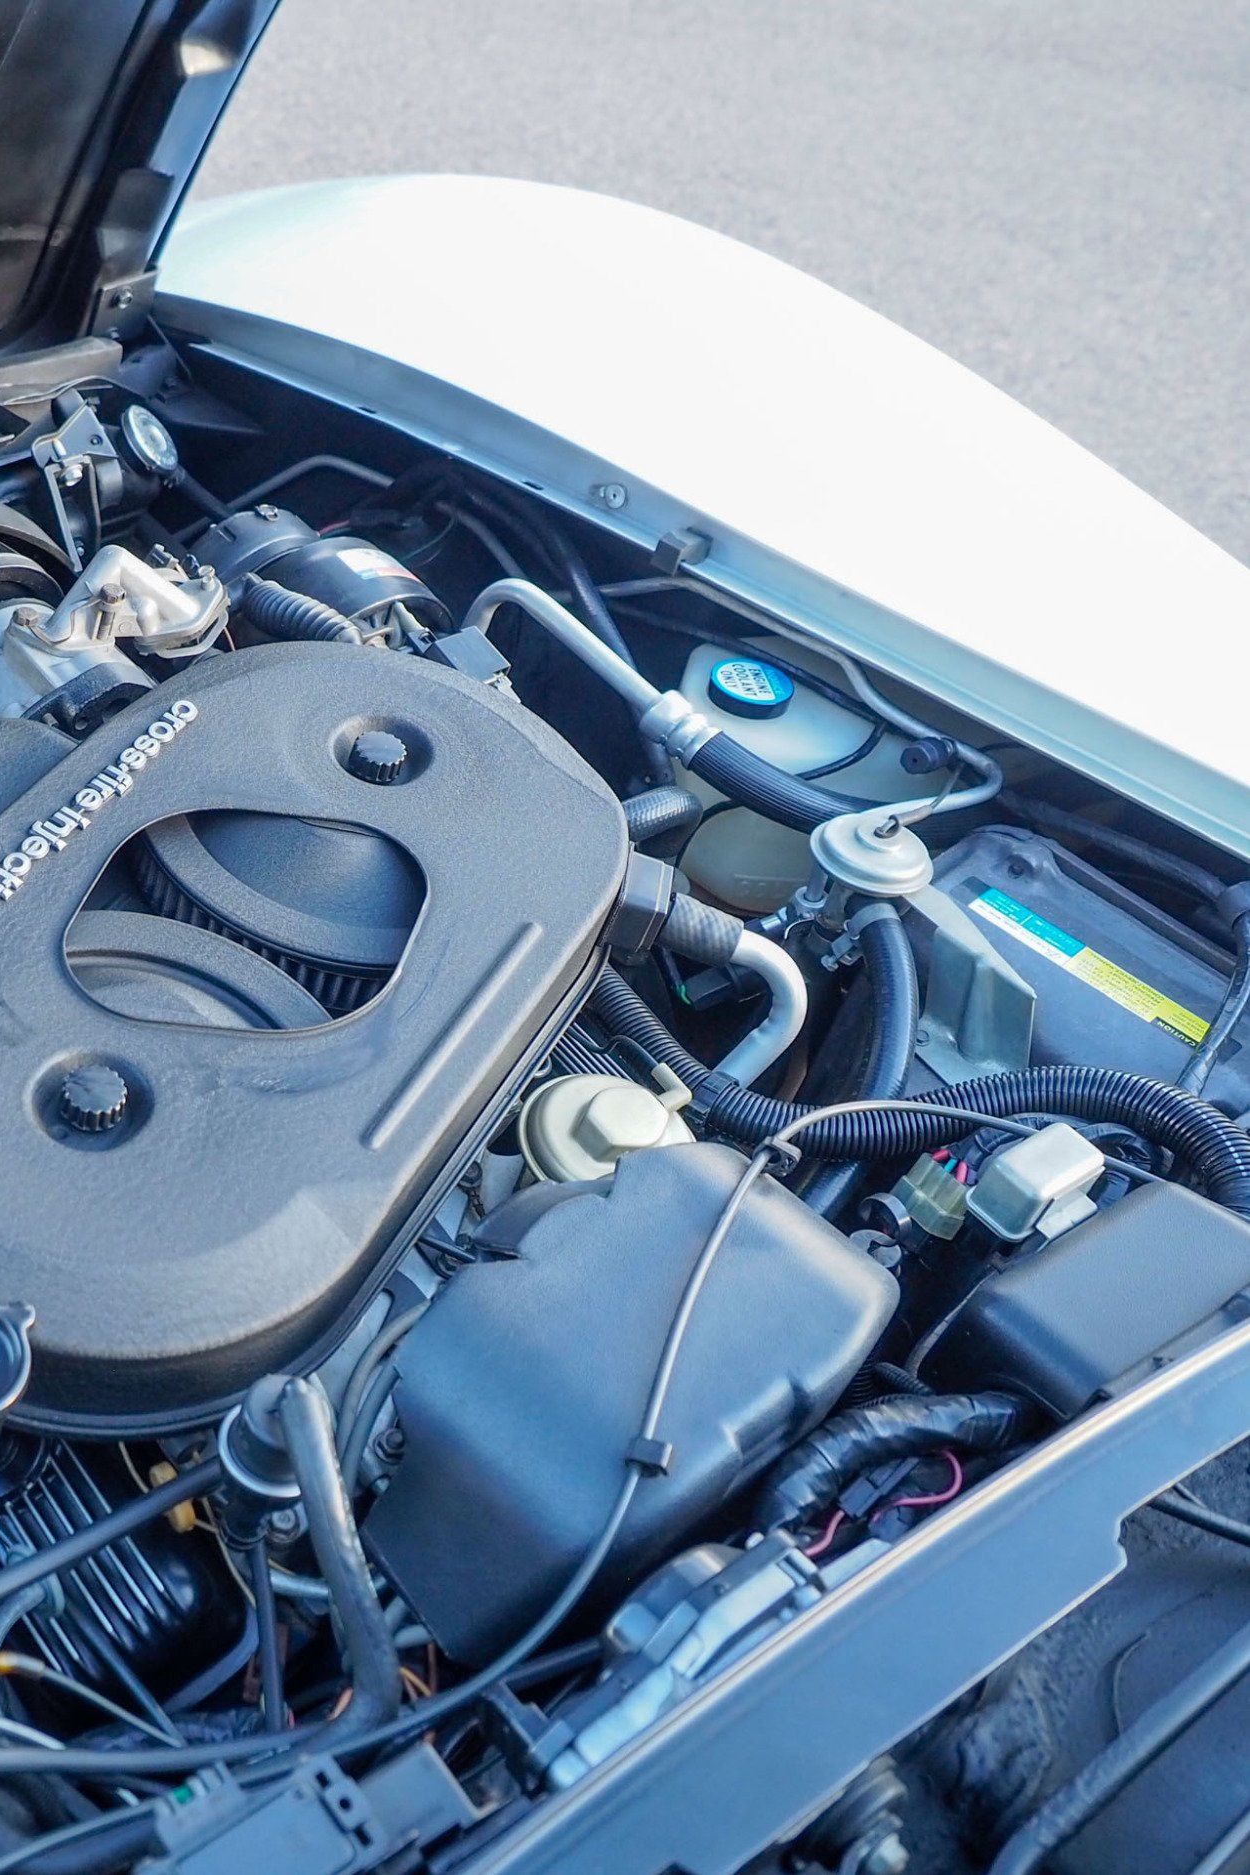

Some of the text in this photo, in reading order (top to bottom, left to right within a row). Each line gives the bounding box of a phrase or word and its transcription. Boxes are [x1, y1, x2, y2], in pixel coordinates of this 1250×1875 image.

[720, 670, 738, 688] ONLY
[732, 664, 757, 696] COOLANT
[748, 668, 772, 694] ENGINE
[1157, 1020, 1197, 1048] CAUTION
